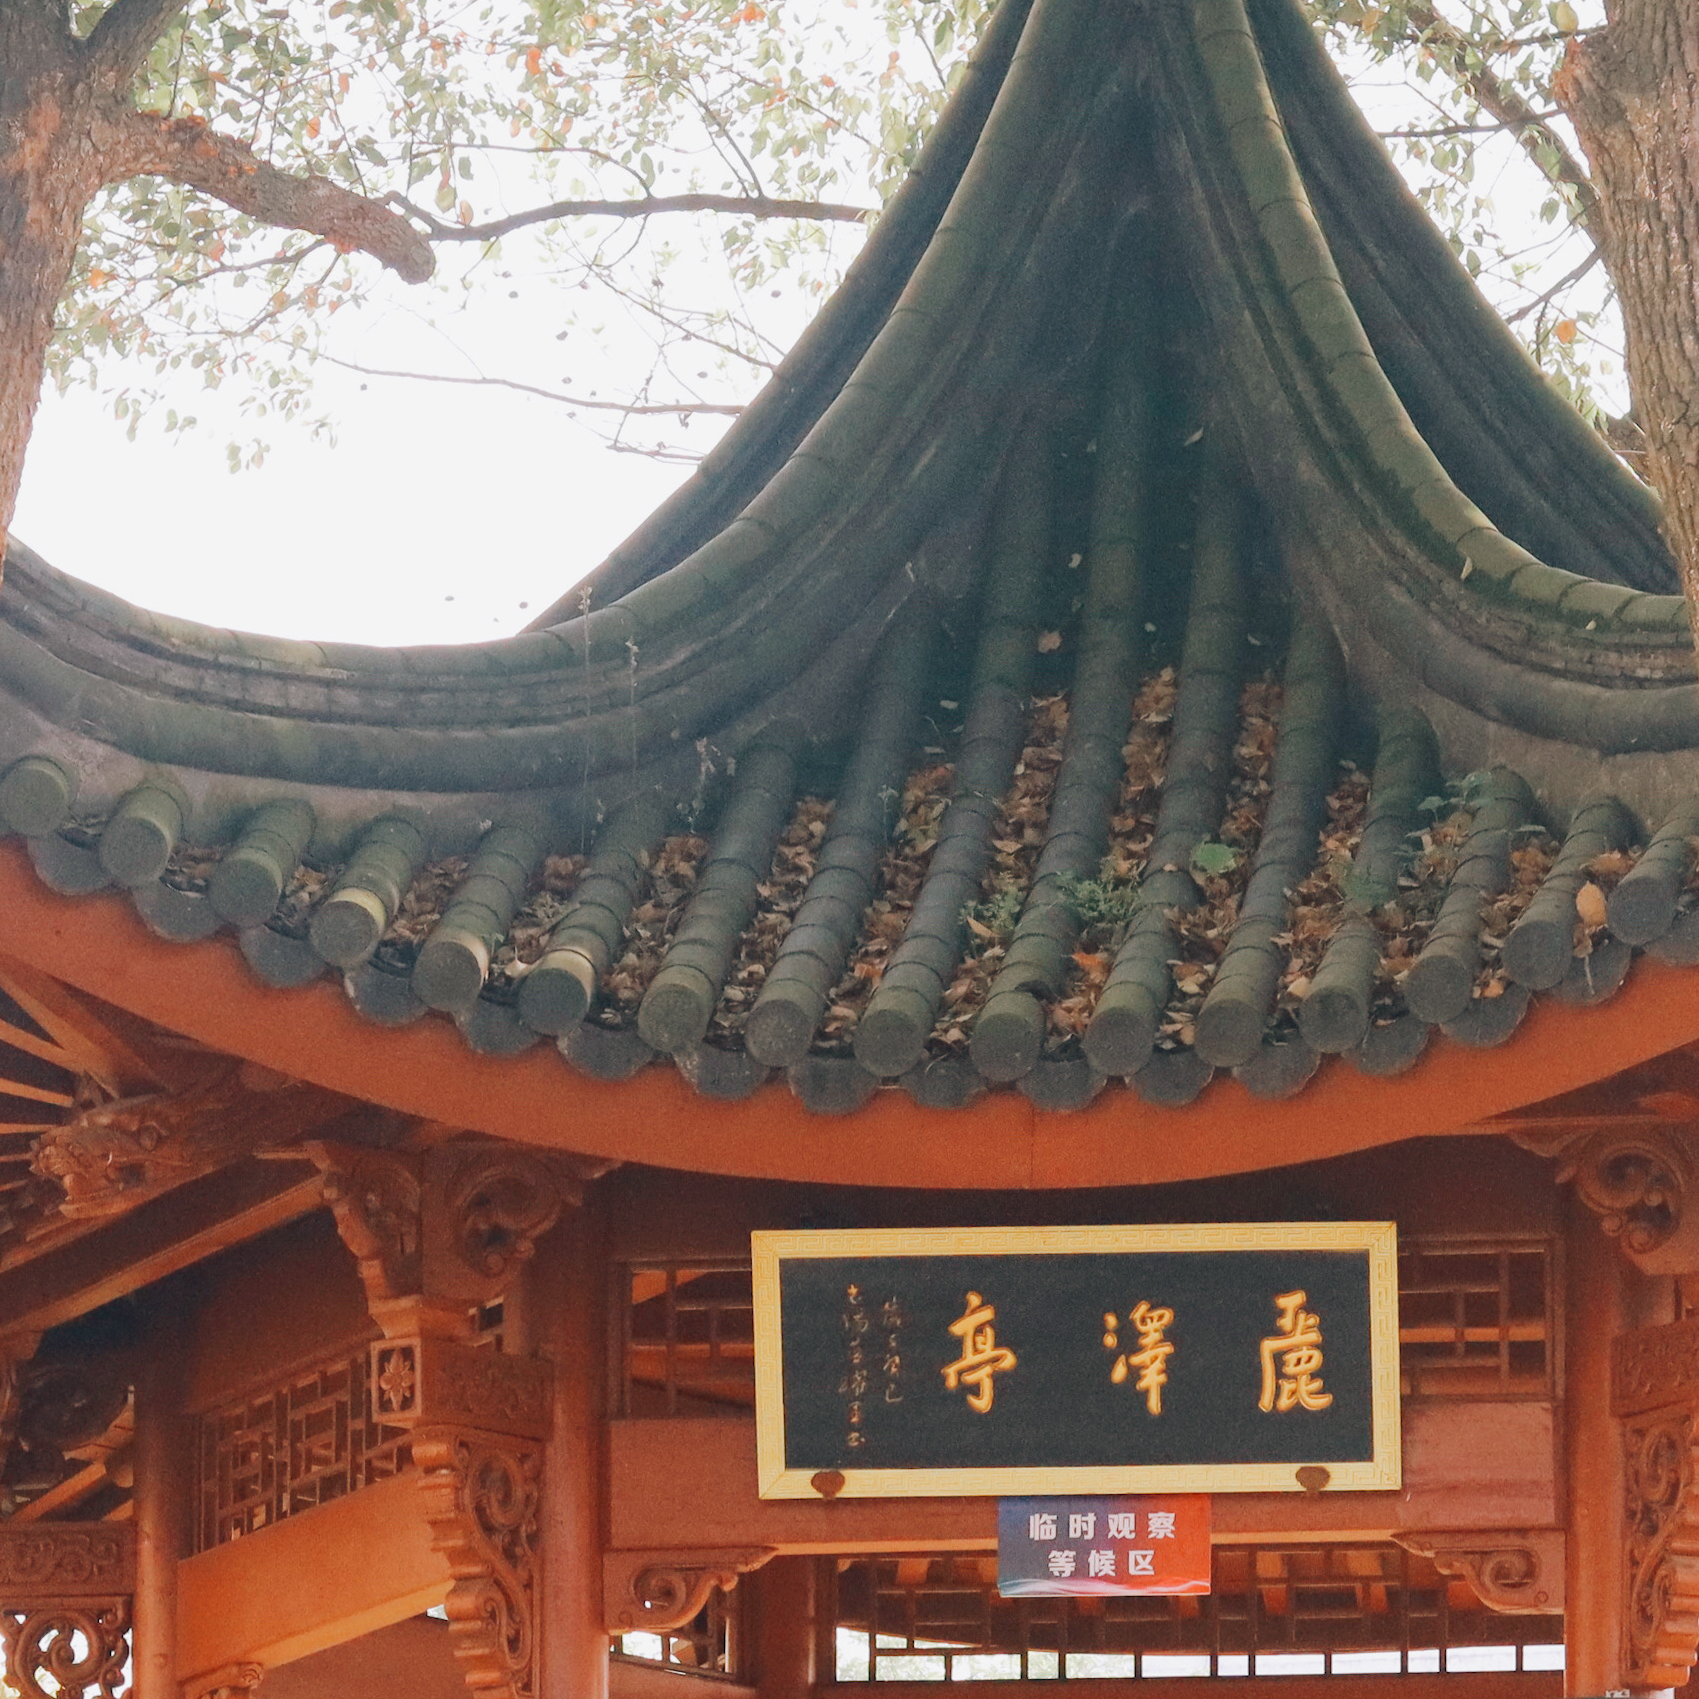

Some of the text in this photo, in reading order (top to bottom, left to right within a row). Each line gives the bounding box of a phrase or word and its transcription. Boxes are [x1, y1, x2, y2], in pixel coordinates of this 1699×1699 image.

[1029, 1511, 1176, 1541] 临时观察
[1047, 1550, 1155, 1577] 等候区
